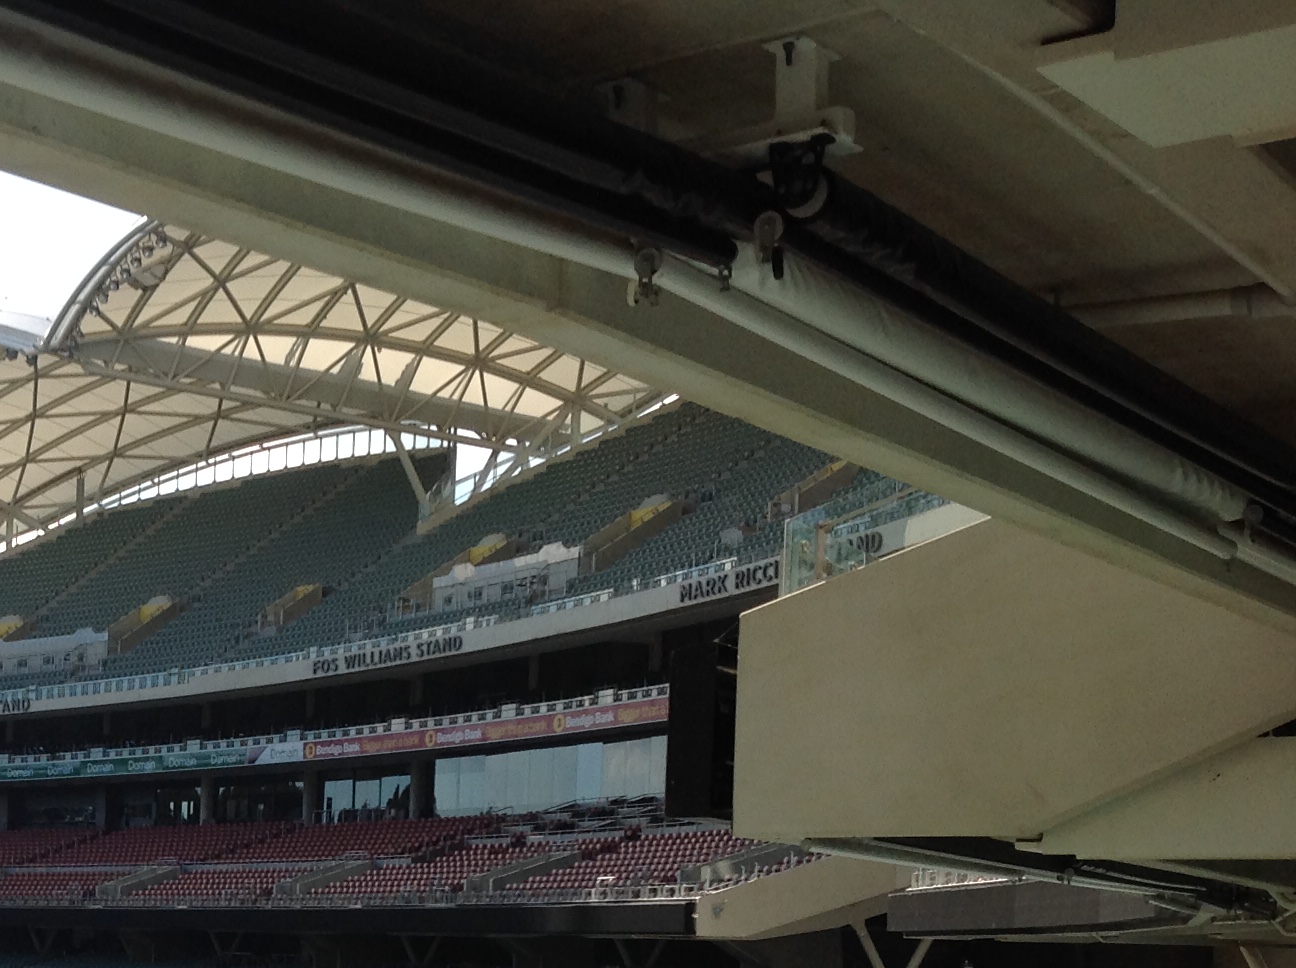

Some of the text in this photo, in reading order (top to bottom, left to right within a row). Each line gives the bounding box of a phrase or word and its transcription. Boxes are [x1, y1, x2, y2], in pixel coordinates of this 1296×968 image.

[679, 573, 728, 603] MARK
[312, 635, 463, 675] FOS WILLIAMS STAND
[595, 710, 615, 722] Bank
[436, 731, 464, 744] Bendigo
[464, 728, 482, 739] Bank
[316, 744, 343, 756] Bendigo
[343, 742, 360, 752] Bank
[128, 760, 156, 771] Domain
[168, 757, 196, 767] Domain
[6, 768, 33, 778] Domain
[47, 764, 73, 775] Domain
[87, 763, 115, 773] Domain
